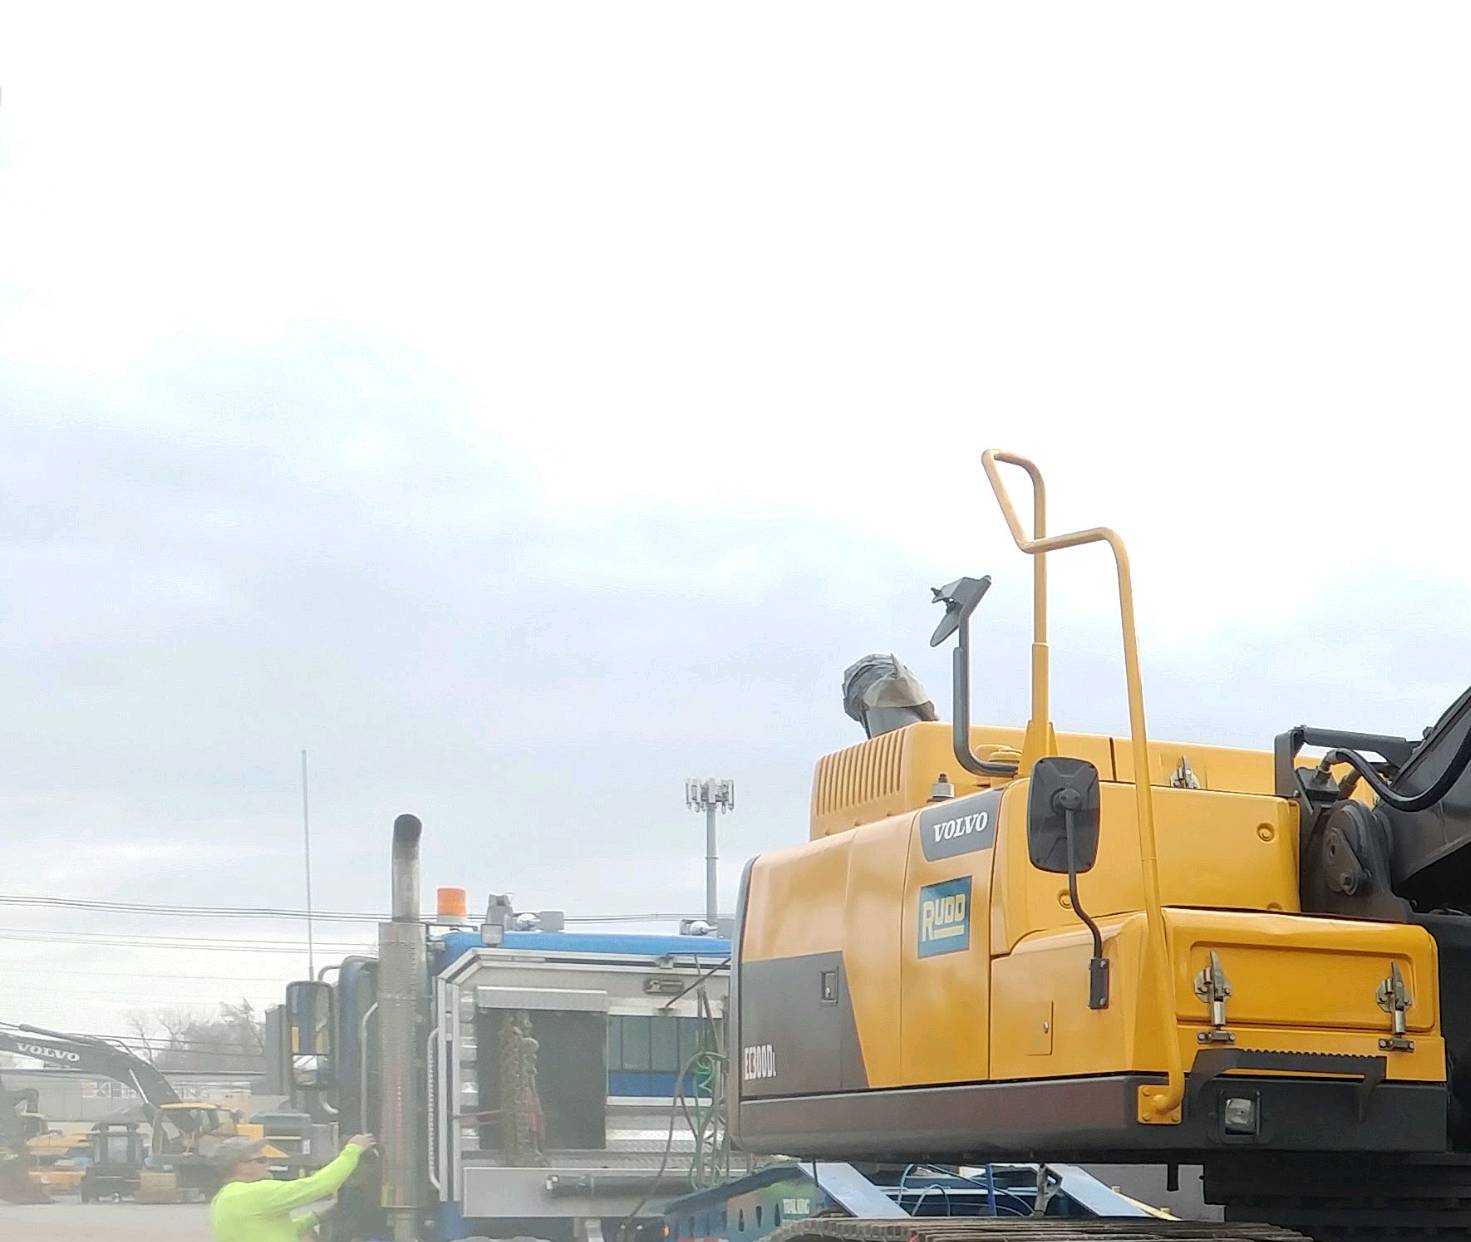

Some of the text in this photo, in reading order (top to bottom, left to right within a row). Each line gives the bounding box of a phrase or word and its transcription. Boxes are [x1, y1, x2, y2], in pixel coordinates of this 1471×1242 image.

[934, 811, 988, 842] VOLVO
[922, 893, 966, 942] RUDD
[16, 1042, 80, 1063] VOLVO
